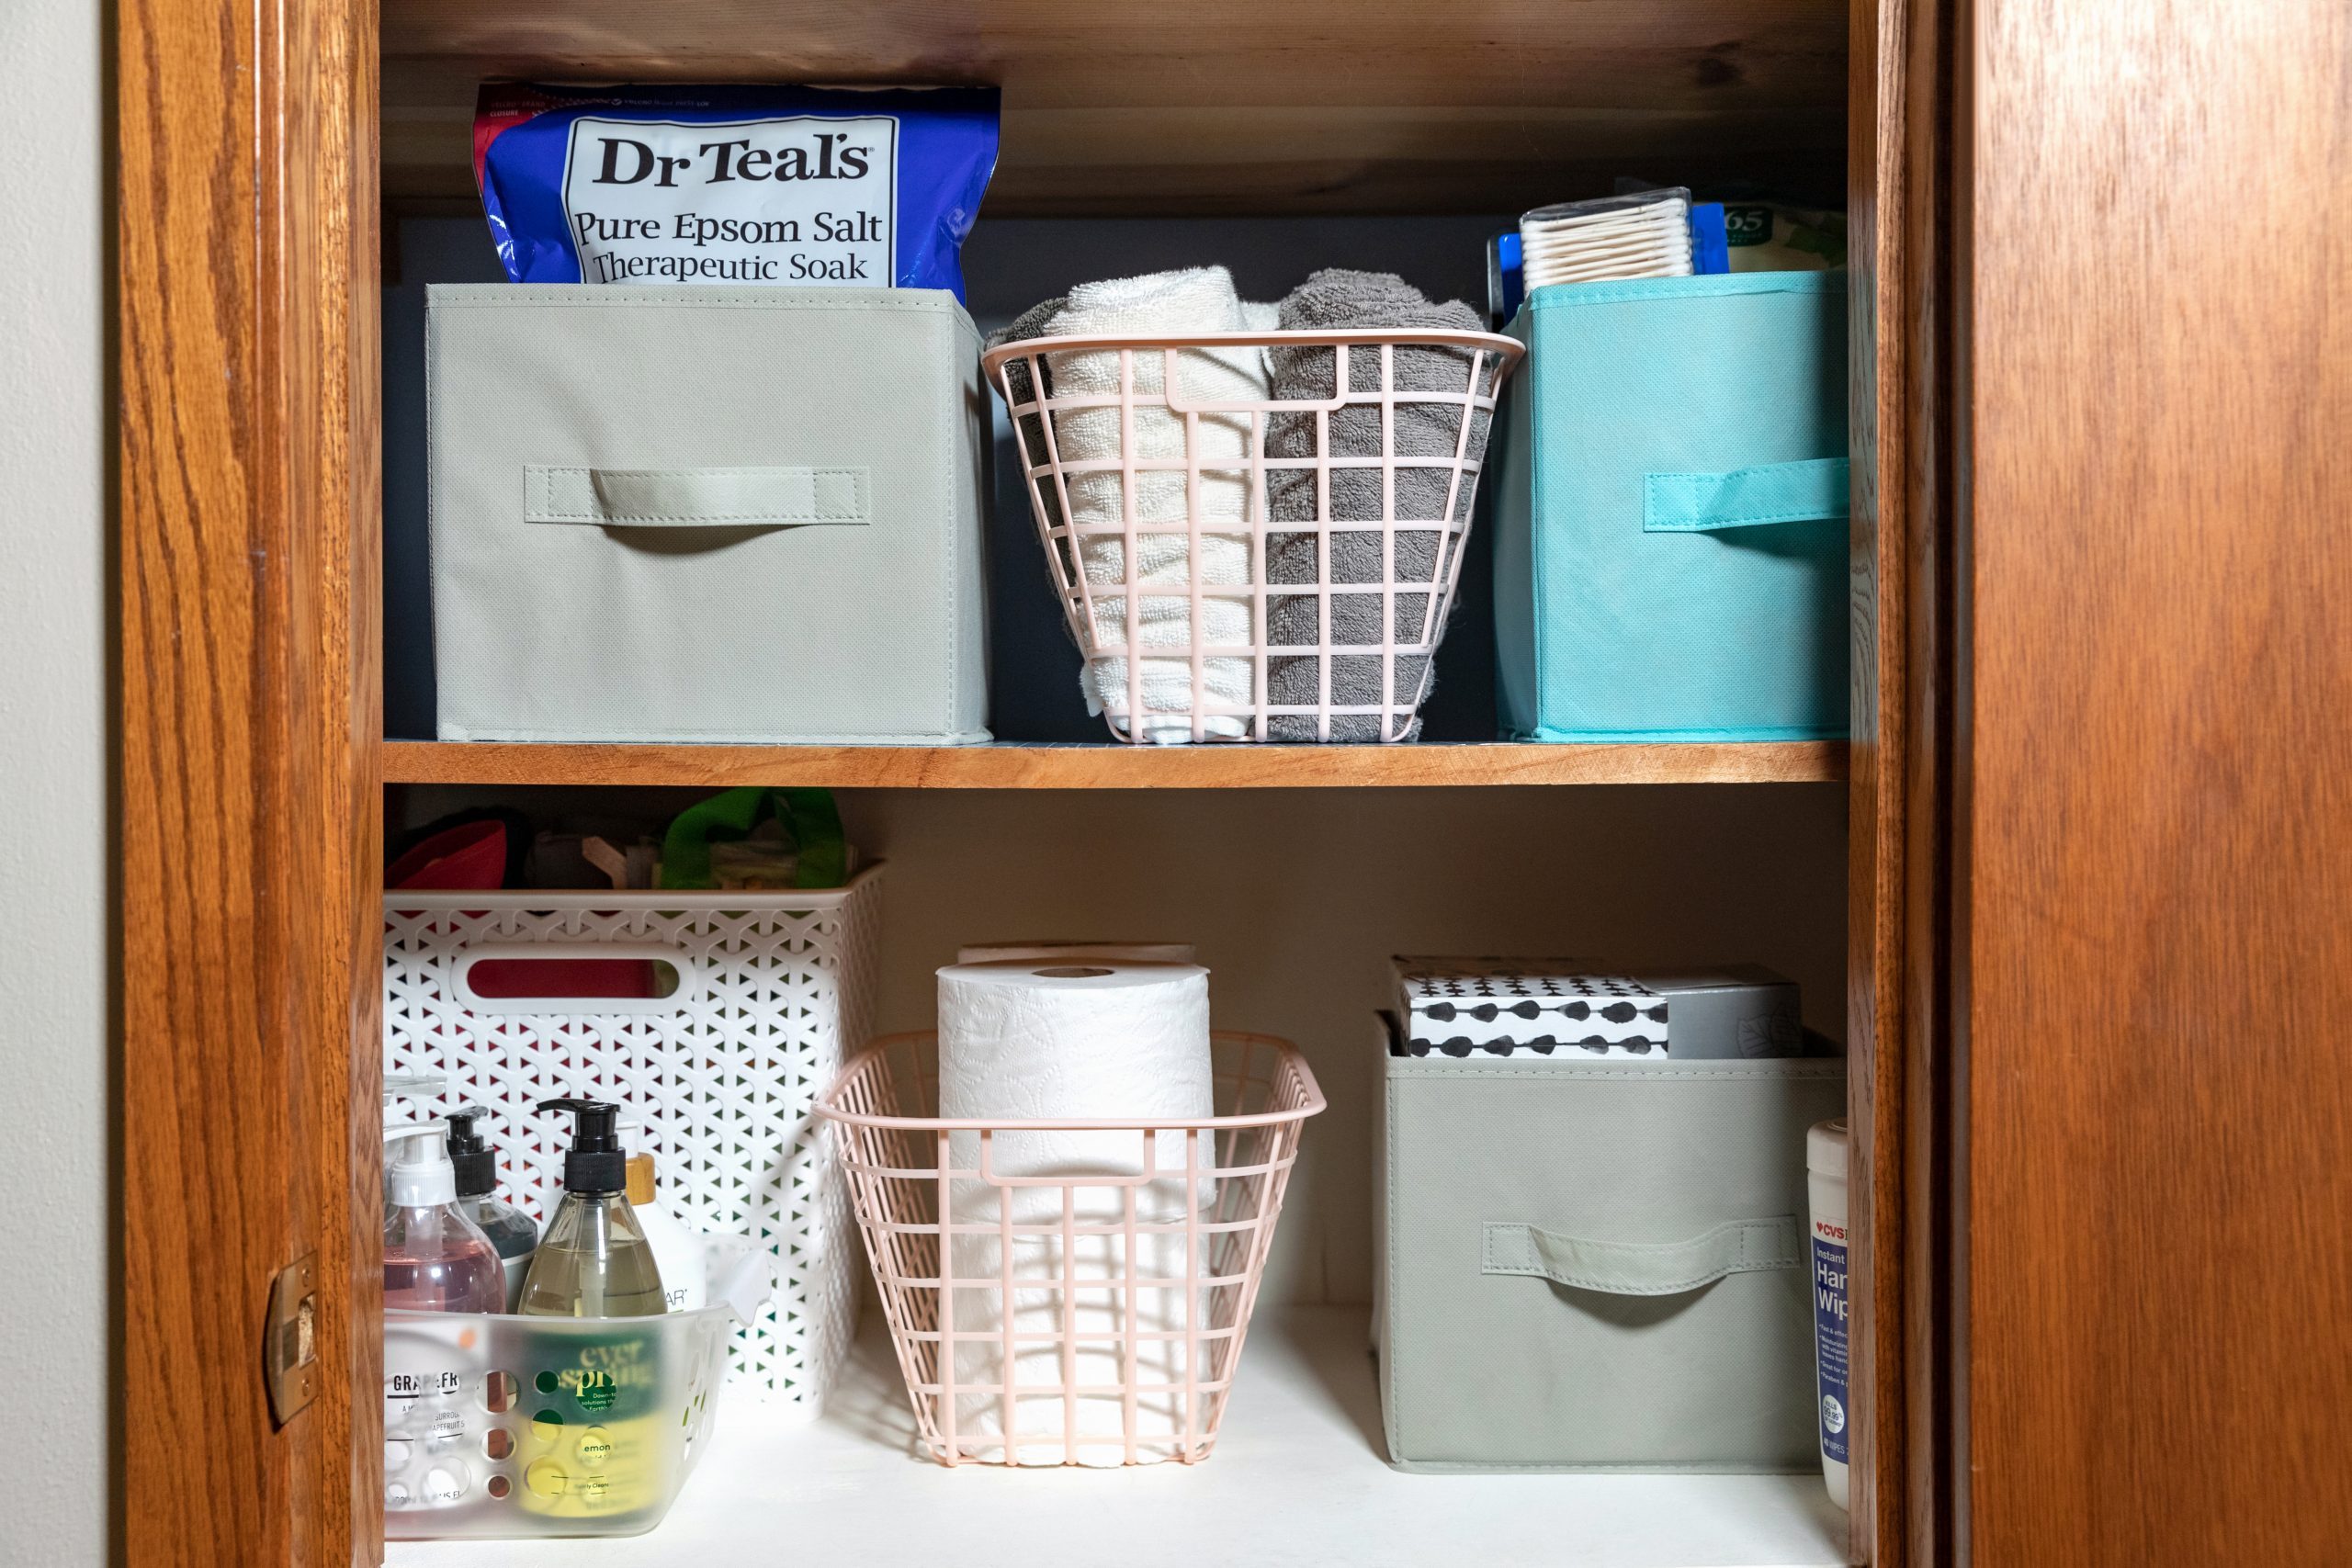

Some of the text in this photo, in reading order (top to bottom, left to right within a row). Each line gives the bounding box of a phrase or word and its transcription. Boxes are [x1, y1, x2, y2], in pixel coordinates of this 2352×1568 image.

[490, 109, 519, 118] CLOSURE
[592, 133, 870, 187] Dr Teal's
[574, 210, 884, 247] Pure Epsom Salt
[594, 251, 869, 284] Therapeutic Soak
[1816, 1246, 1846, 1265] Instant
[583, 1444, 611, 1452] emon
[1829, 1439, 1845, 1455] WIPES
